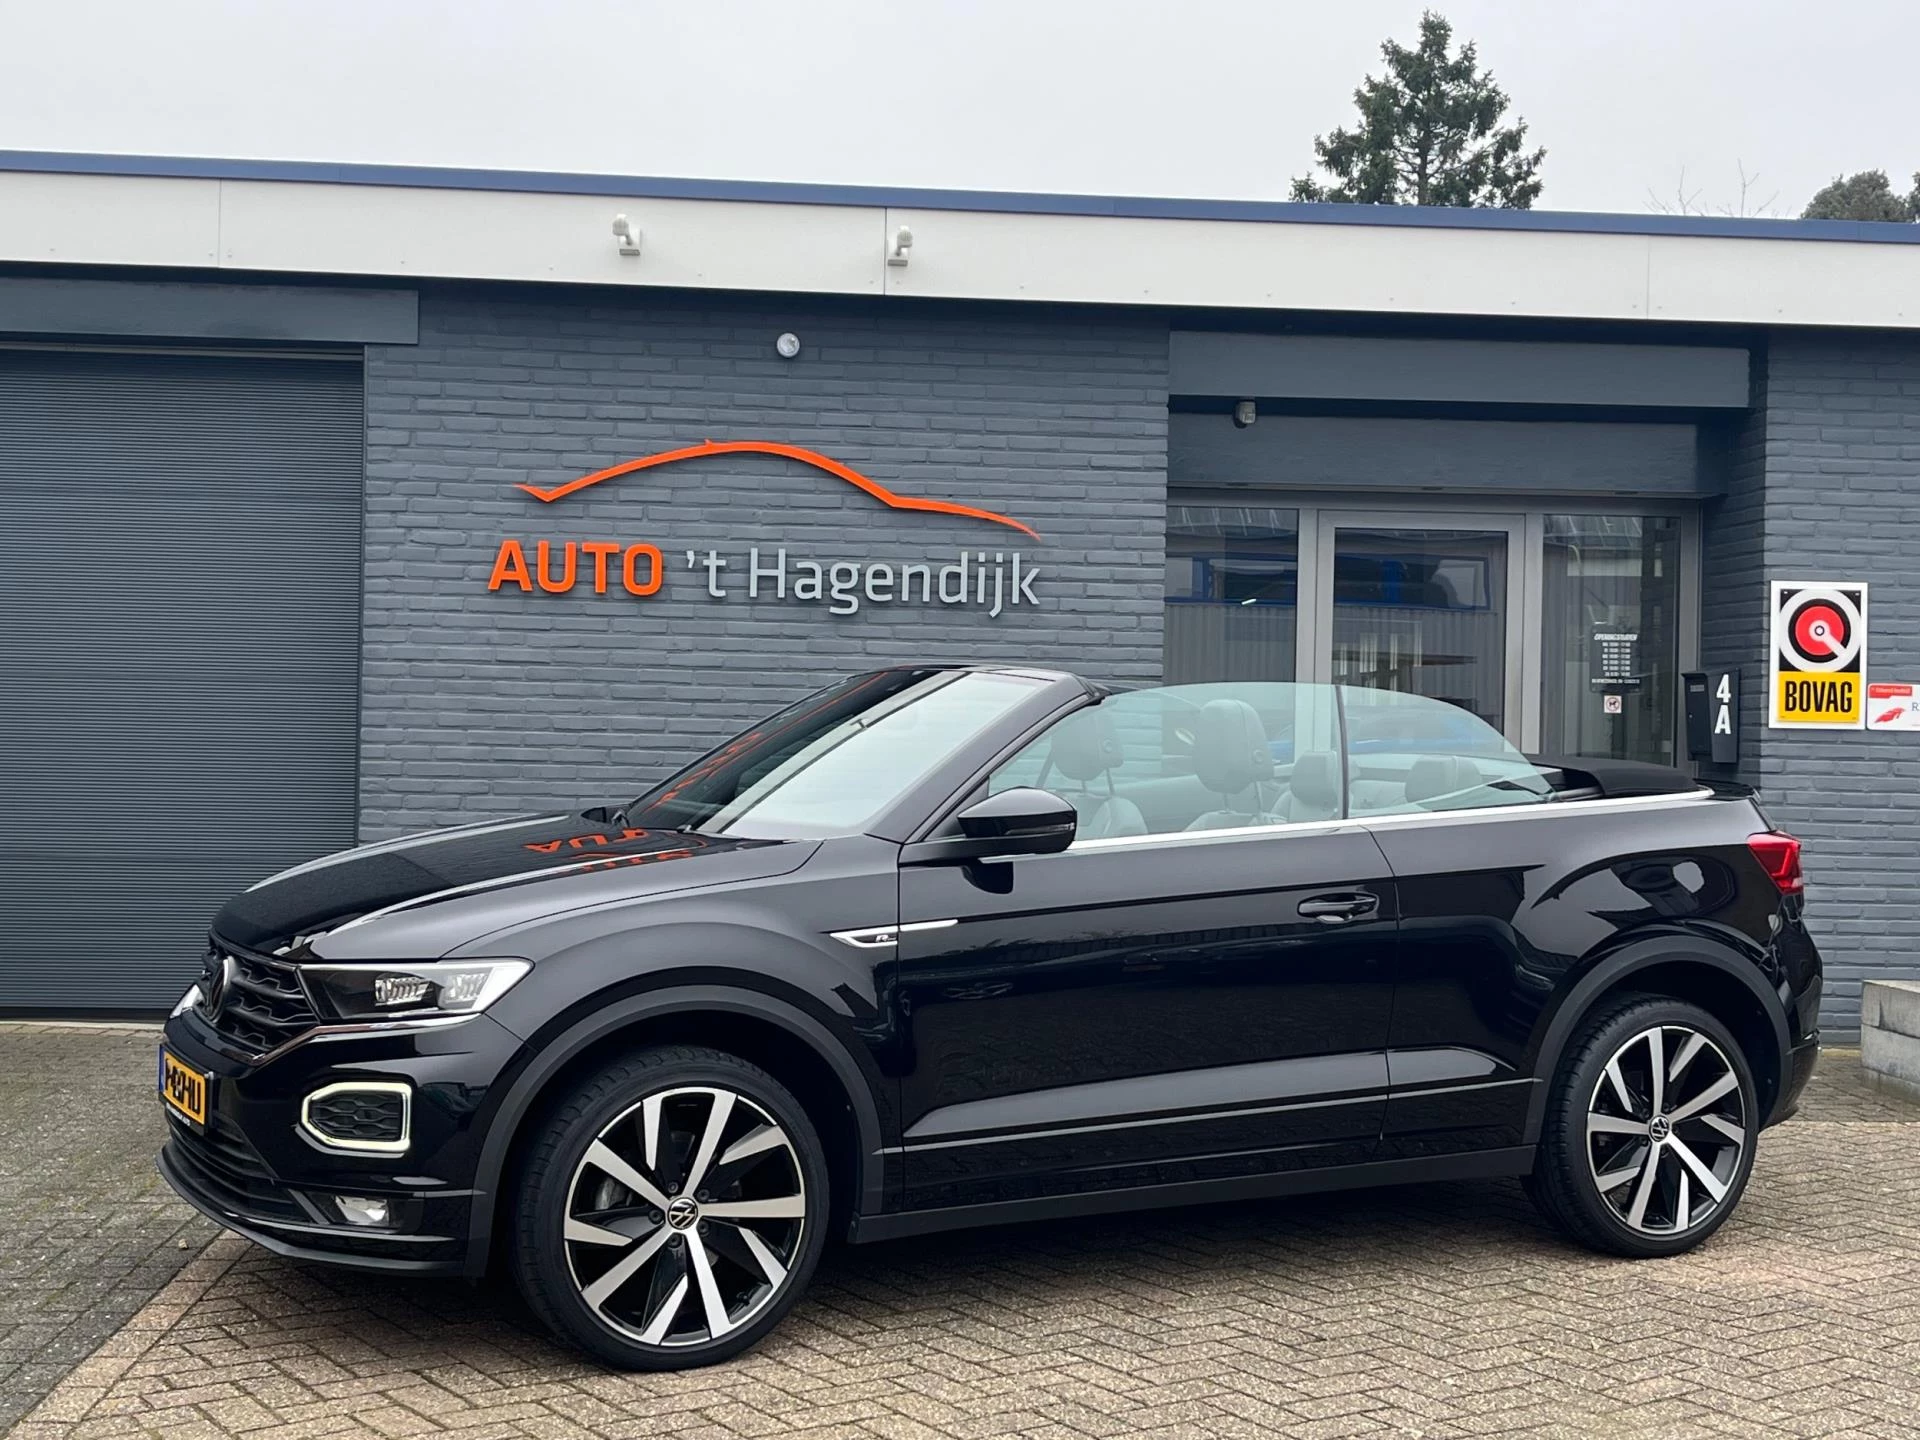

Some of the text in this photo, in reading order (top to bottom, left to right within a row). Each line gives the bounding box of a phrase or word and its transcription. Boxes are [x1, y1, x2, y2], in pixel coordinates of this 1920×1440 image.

[488, 540, 664, 597] AUTO
[749, 547, 1041, 618] Hagendijk
[1716, 674, 1732, 703] 4
[1784, 680, 1853, 713] BOVAG
[1714, 705, 1732, 735] A
